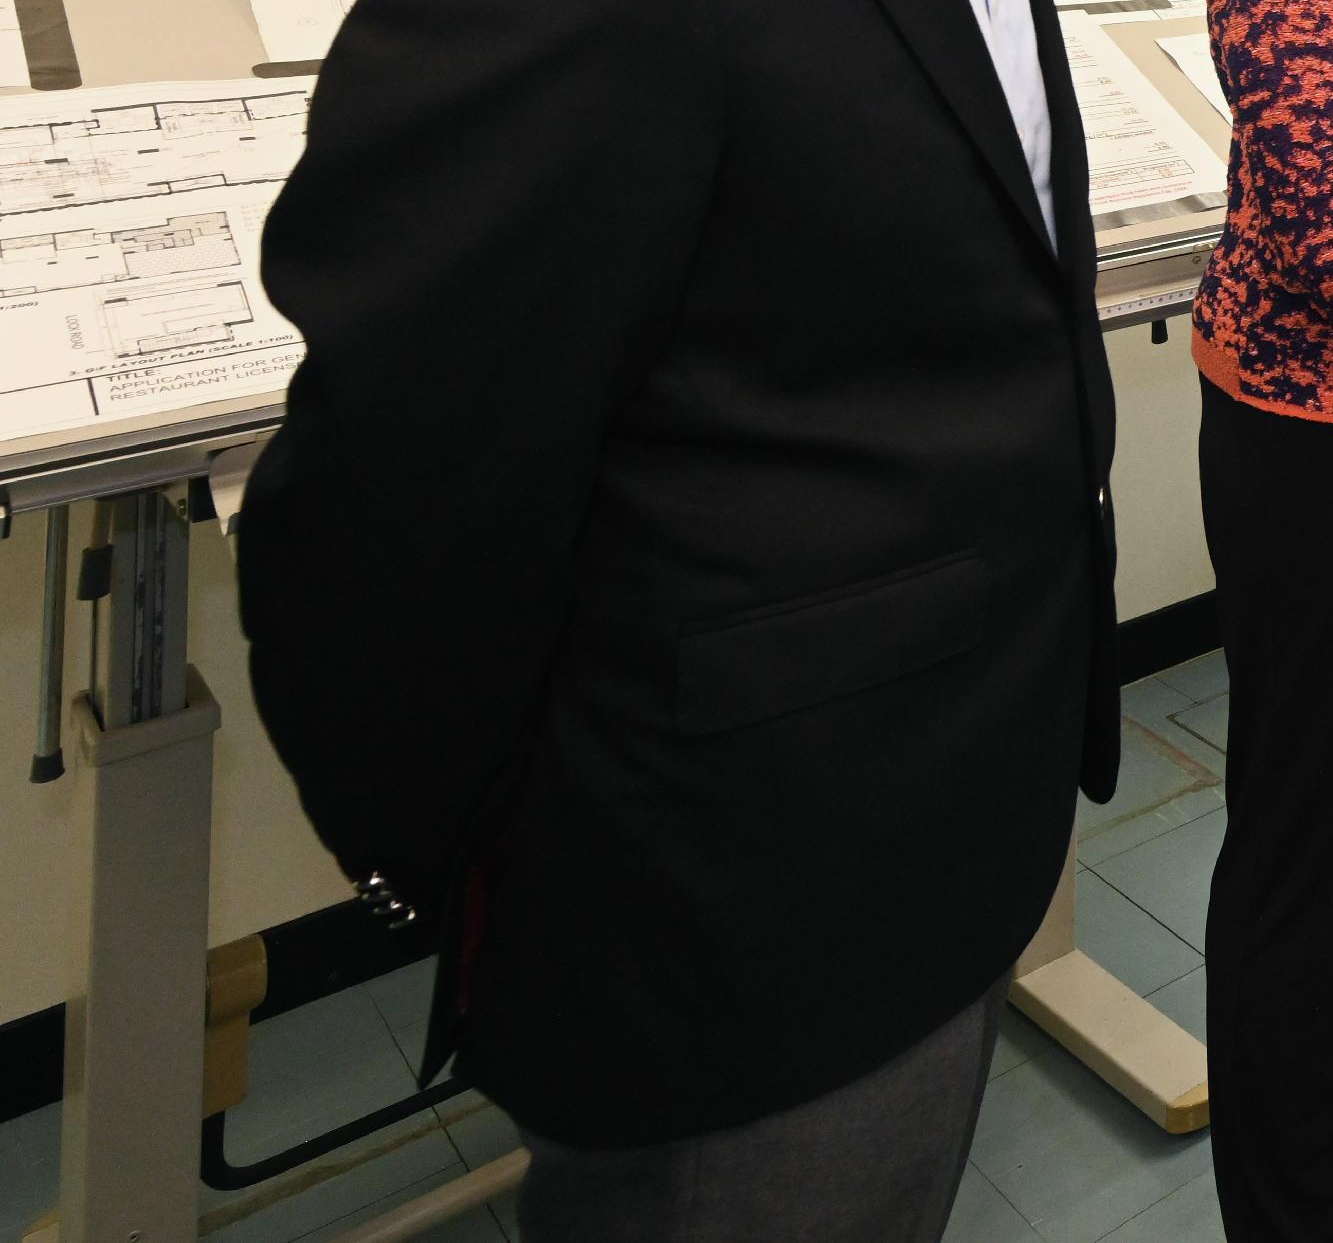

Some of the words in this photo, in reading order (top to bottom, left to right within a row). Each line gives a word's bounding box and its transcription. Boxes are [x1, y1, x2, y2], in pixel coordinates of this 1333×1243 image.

[66, 315, 80, 331] LOCK
[70, 332, 84, 349] ROAD
[112, 356, 167, 369] LAYOUT
[170, 349, 204, 359] PLAN
[208, 341, 253, 353] (SCALE
[257, 335, 293, 344] 1:100)
[106, 369, 161, 382] TITLE:
[110, 367, 226, 392] APPLICATION
[232, 360, 266, 371] FOR
[110, 375, 230, 401] RESTAURANT
